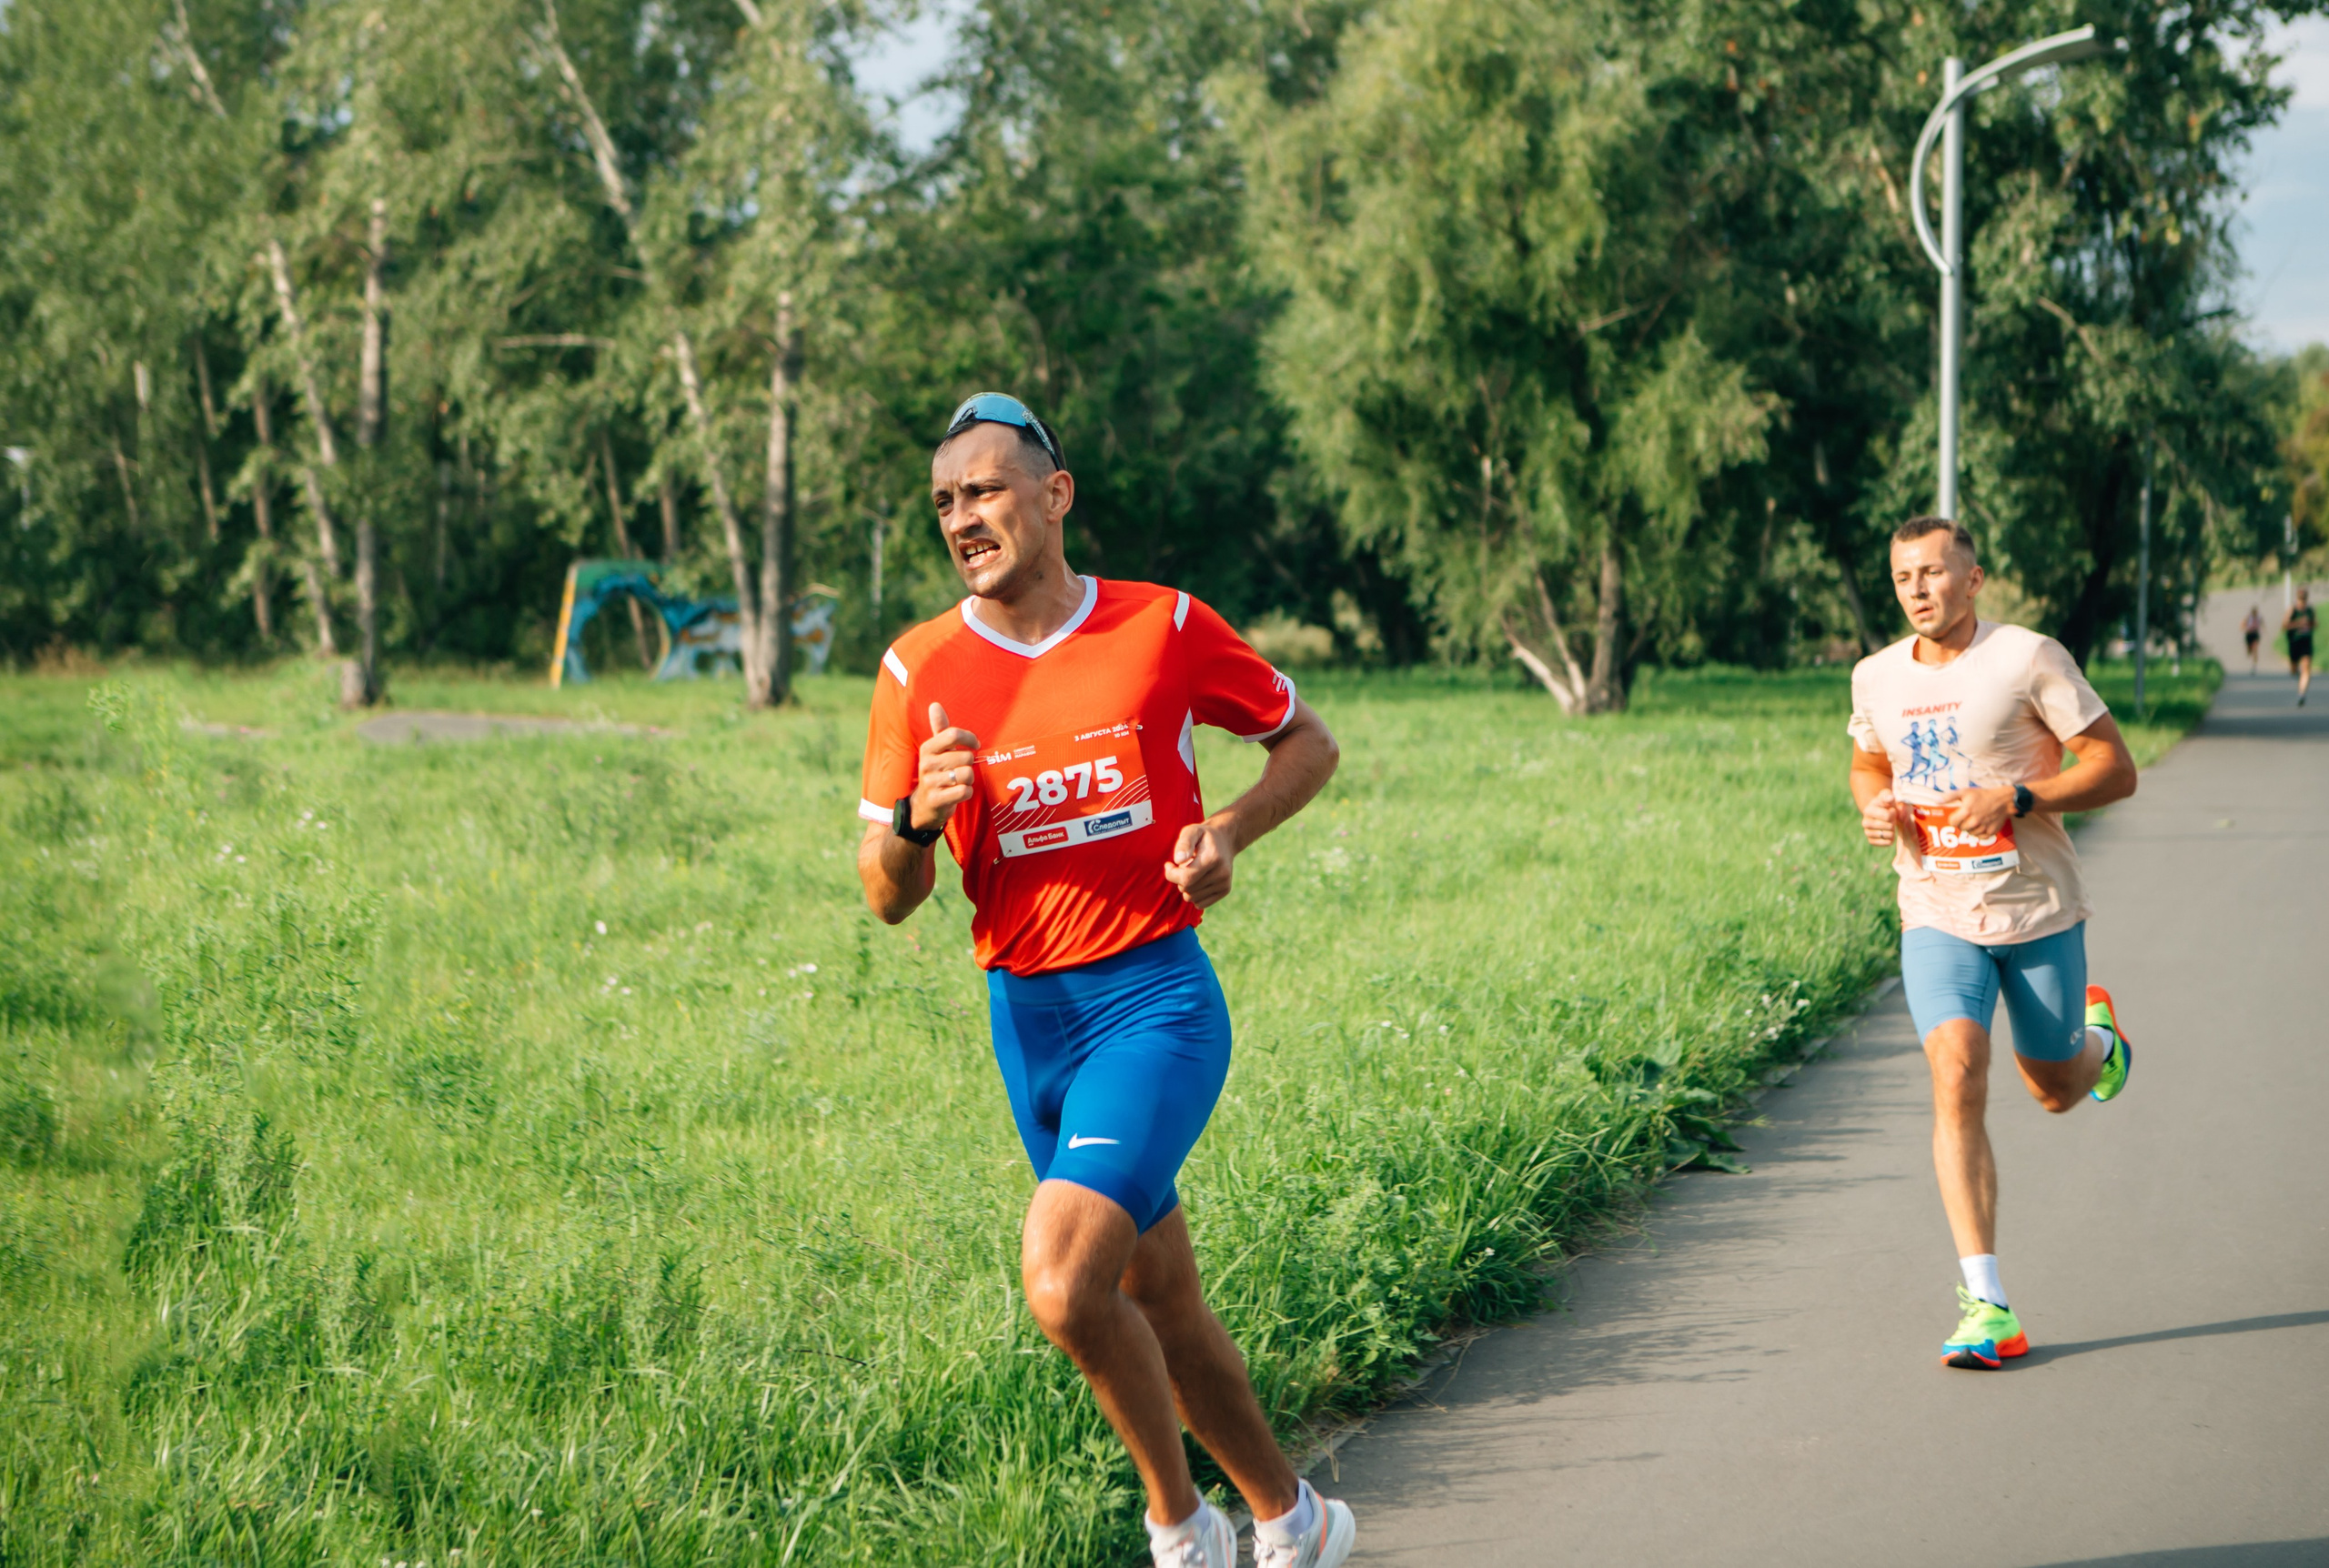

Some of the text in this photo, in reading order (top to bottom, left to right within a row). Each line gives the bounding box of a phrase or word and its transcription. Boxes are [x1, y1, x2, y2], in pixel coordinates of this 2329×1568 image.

[1901, 701, 1962, 718] INSANITY
[1080, 728, 1112, 740] АВГУСТА
[1006, 755, 1124, 813] 2875
[1093, 818, 1130, 831] Следопыт
[1028, 831, 1064, 844] Альфа Банк
